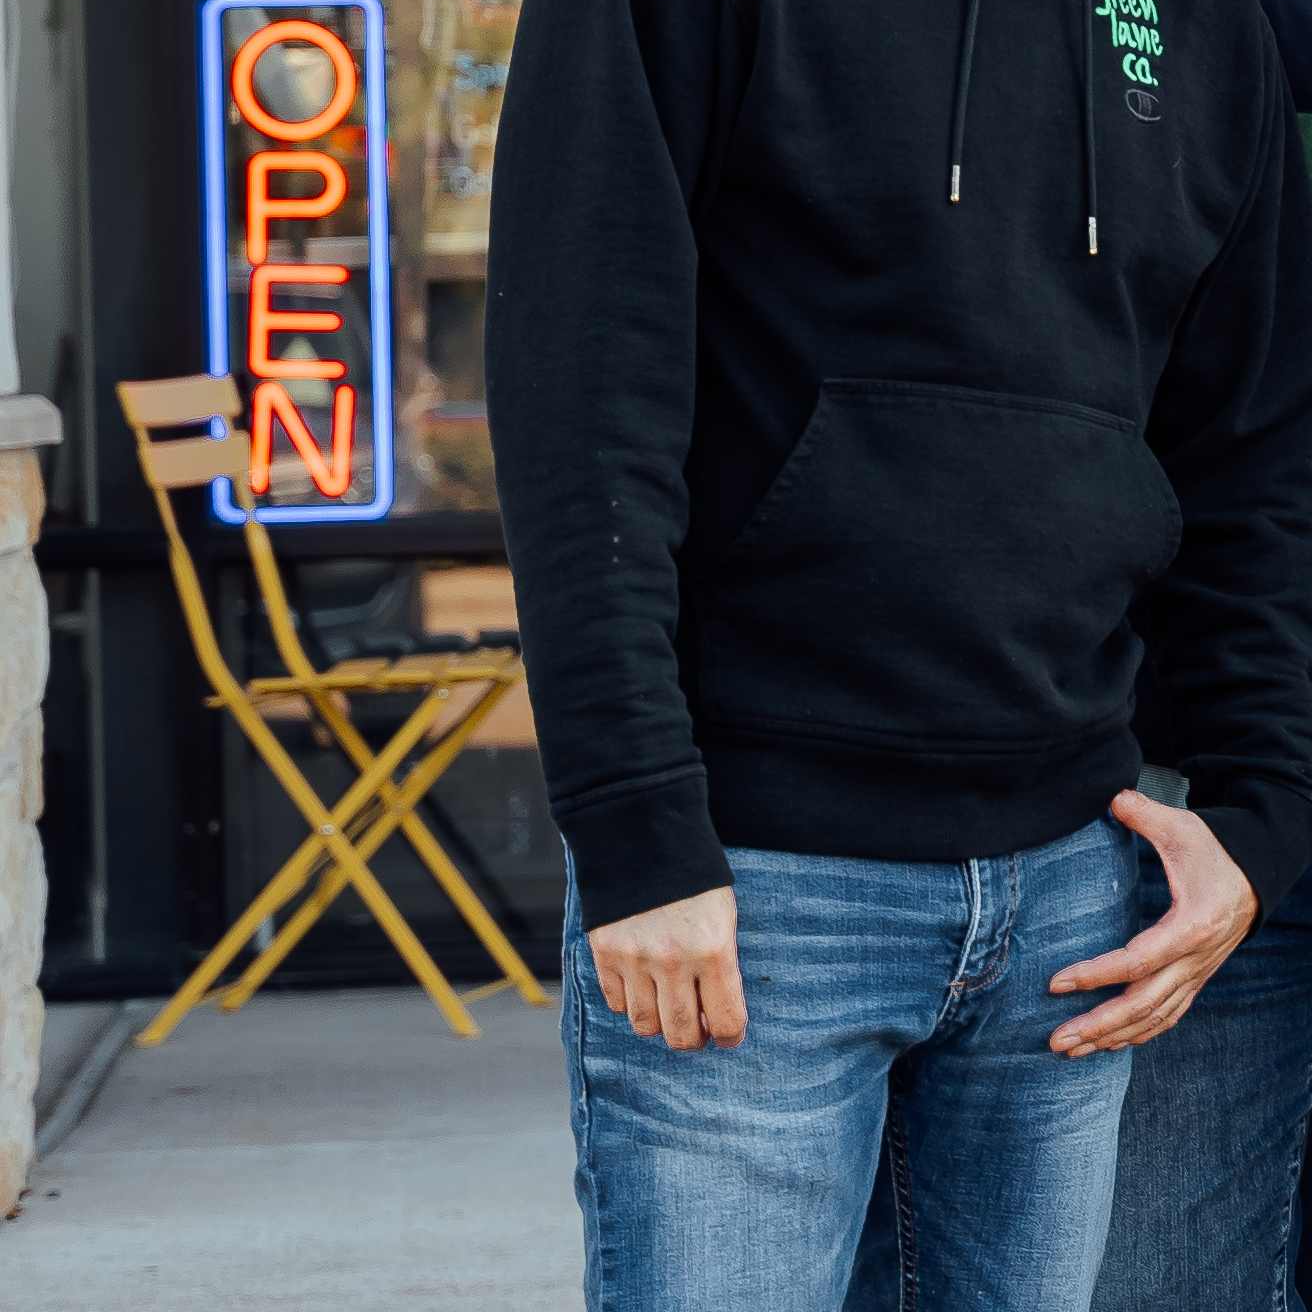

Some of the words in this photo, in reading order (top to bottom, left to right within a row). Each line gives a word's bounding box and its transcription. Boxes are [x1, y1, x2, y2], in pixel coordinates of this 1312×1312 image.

[1111, 8, 1164, 56] lane
[1122, 52, 1159, 87] co.
[231, 19, 358, 498] OPEN
